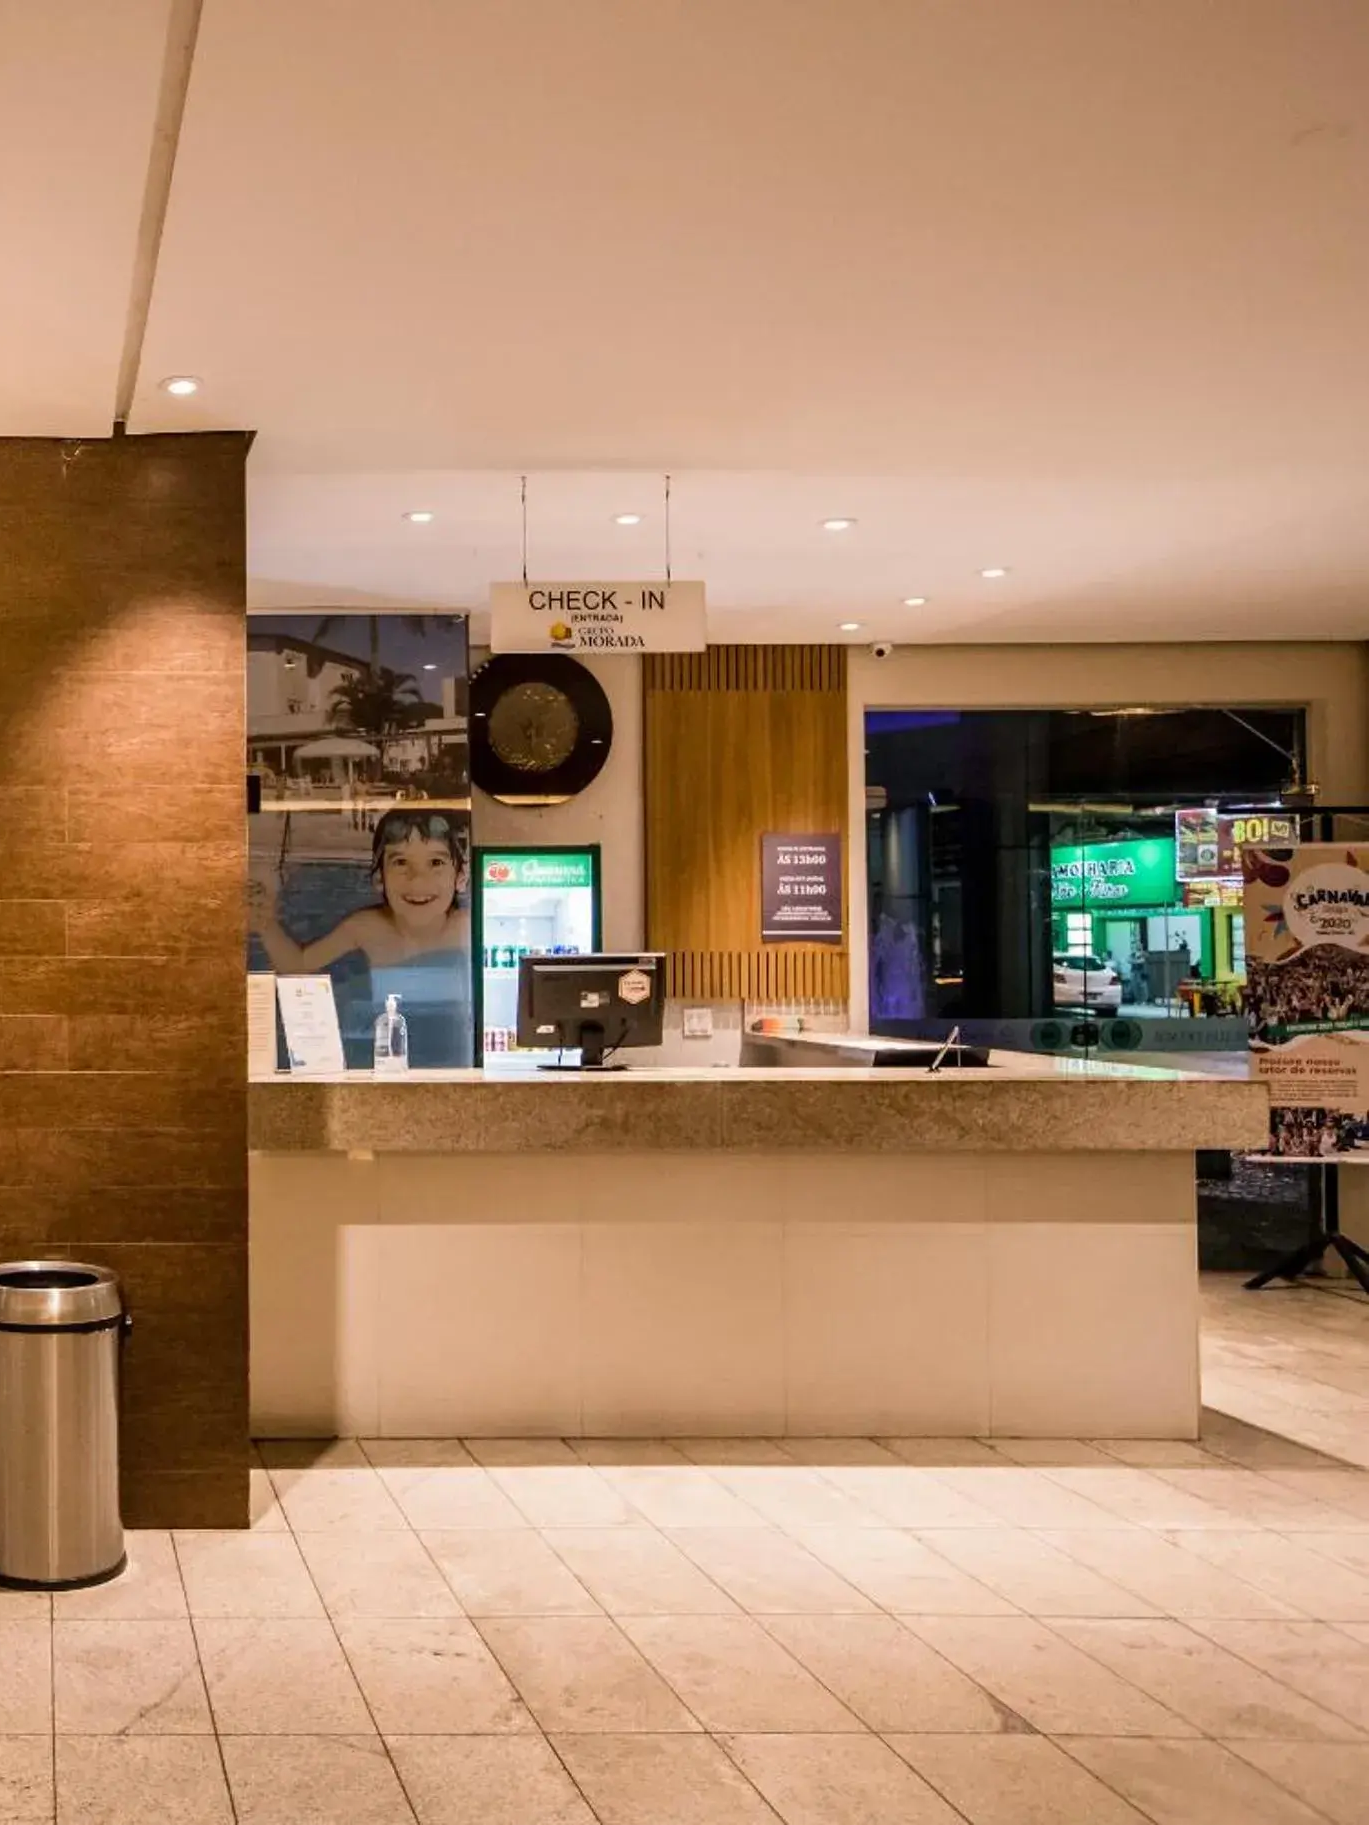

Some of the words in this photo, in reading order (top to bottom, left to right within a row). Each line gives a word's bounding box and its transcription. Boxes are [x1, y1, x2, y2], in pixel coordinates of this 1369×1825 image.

[528, 590, 618, 610] CHECK
[641, 590, 665, 610] IN
[579, 635, 645, 648] MORADA
